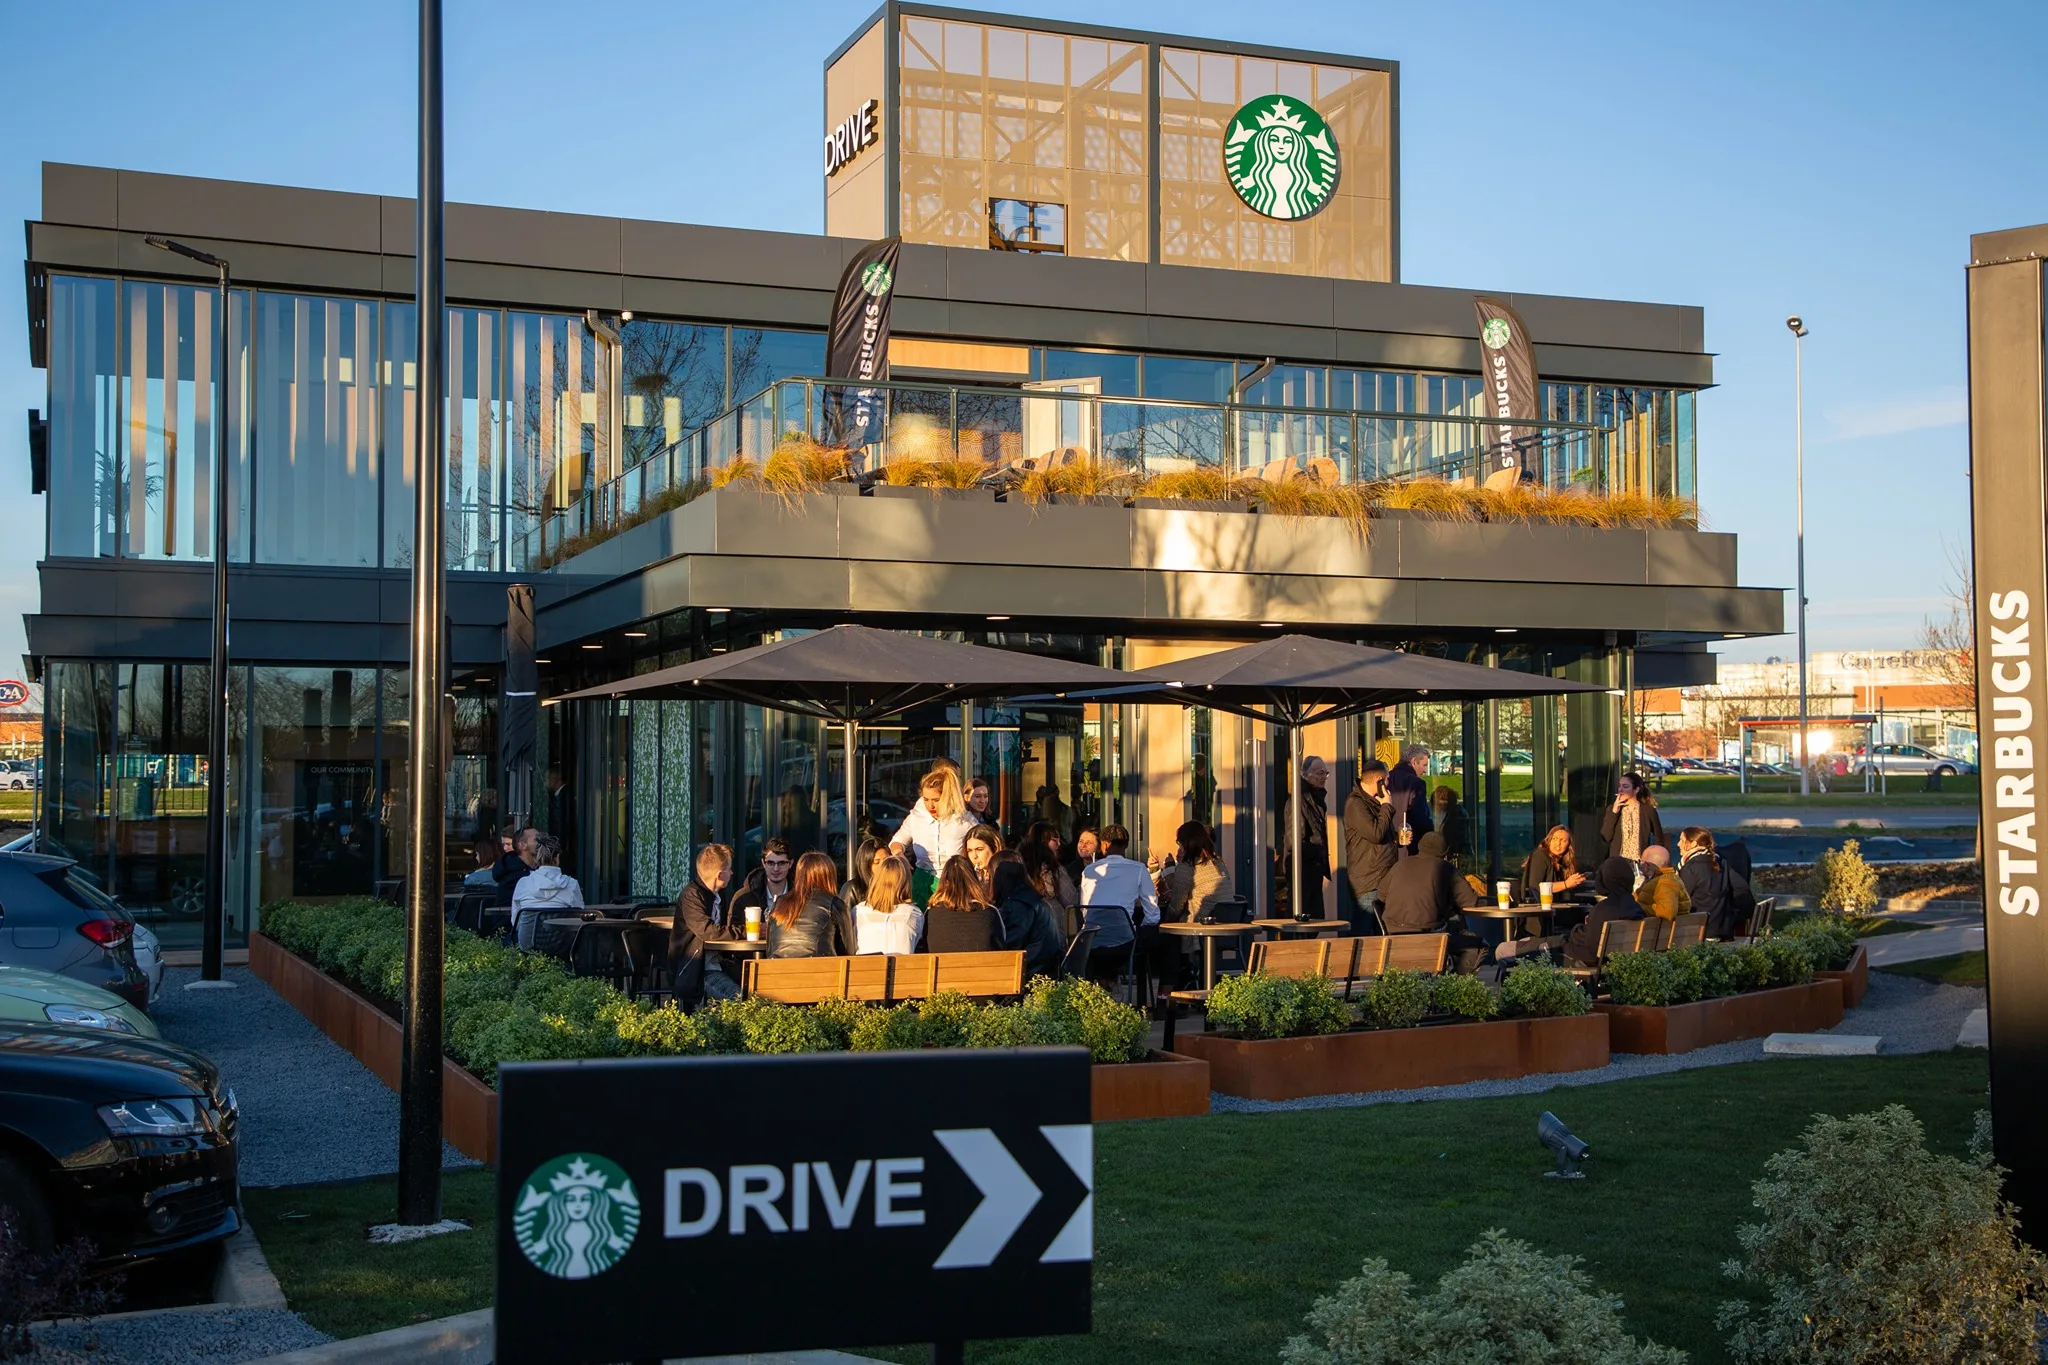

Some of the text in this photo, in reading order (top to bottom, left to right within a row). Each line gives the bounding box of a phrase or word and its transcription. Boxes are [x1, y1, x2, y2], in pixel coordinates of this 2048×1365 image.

[824, 99, 875, 176] DRIVE
[310, 766, 374, 774] OUR COMMUNITY
[1989, 589, 2040, 917] STARBUCKS
[663, 1157, 926, 1239] DRIVE
